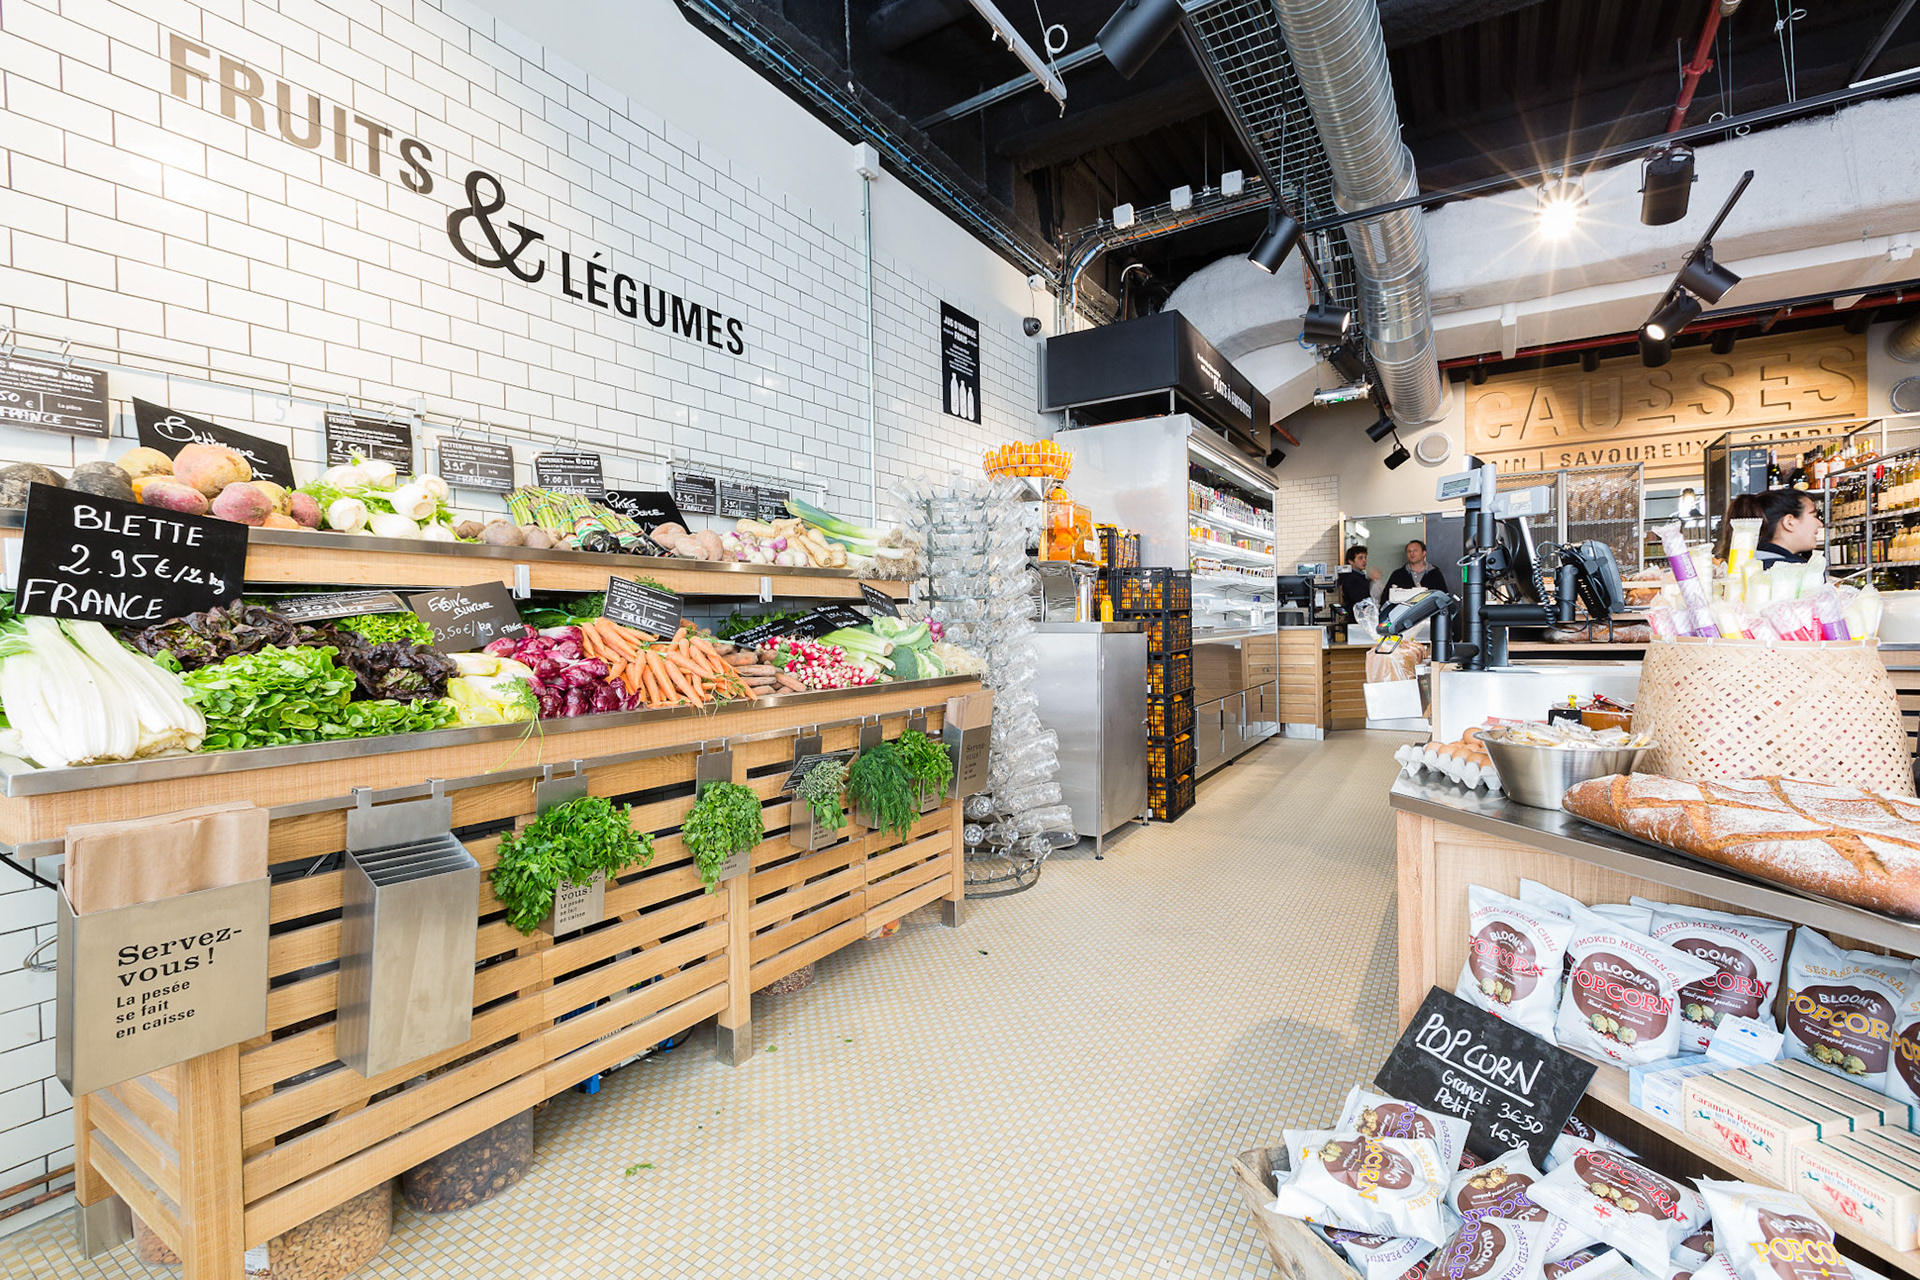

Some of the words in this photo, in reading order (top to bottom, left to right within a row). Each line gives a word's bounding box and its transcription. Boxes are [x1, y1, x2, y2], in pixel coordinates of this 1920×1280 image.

[170, 32, 433, 194] FRUITS
[447, 171, 545, 282] &
[562, 251, 744, 355] LÉGUMES
[1474, 346, 1856, 443] CAUSSES
[1560, 439, 1708, 468] SAVOUREUX
[73, 504, 203, 547] BLETTE
[20, 578, 164, 621] FRANCE
[118, 927, 242, 967] Servez-
[1468, 934, 1548, 976] POPCORN
[1489, 930, 1528, 954] BLOOM'S
[1537, 927, 1558, 952] CHILI
[1574, 936, 1617, 949] SMOKED
[1620, 940, 1667, 971] MEXICAN
[1692, 921, 1748, 940] MEXICAN
[1750, 938, 1778, 964] CHILI
[1570, 965, 1675, 1015] POPCORN
[1592, 961, 1656, 992] BLOOM'S
[1701, 972, 1772, 998] CORN
[1804, 964, 1850, 978] SESAME
[1863, 967, 1885, 980] SEA
[116, 995, 135, 1009] La
[142, 981, 191, 1004] pesée
[116, 1011, 135, 1024] se
[141, 1000, 169, 1017] fait
[1787, 988, 1891, 1042] POPCOR
[1818, 993, 1882, 1015] BLOOM'S
[116, 1026, 136, 1039] en
[142, 1008, 195, 1031] caisse
[1692, 1093, 1735, 1118] Caramels
[1737, 1114, 1775, 1139] Bretons
[1573, 1147, 1688, 1223] POPCORN
[1800, 1155, 1844, 1181] Caramels
[1846, 1177, 1886, 1203] Bretons
[1468, 1229, 1495, 1271] BLOOM'S
[1511, 1223, 1529, 1263] ROASTED
